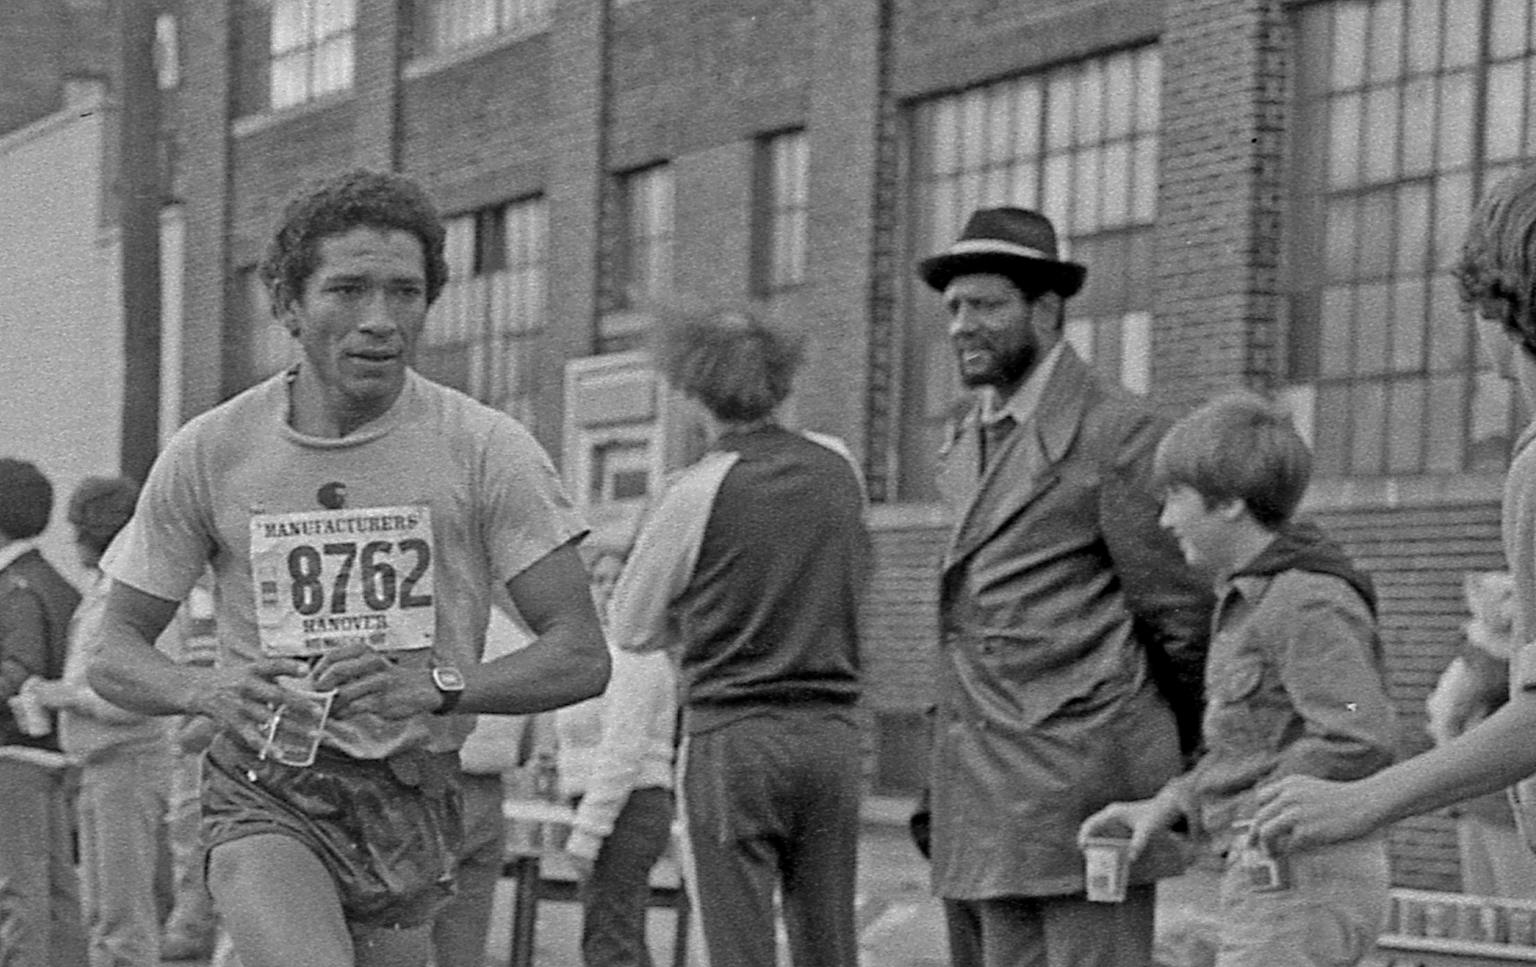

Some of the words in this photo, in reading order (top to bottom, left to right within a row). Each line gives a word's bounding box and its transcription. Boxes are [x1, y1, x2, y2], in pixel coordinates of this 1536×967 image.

[264, 514, 419, 538] MANUFACTURERS
[287, 538, 432, 616] 8762
[303, 615, 388, 633] HANOVER
